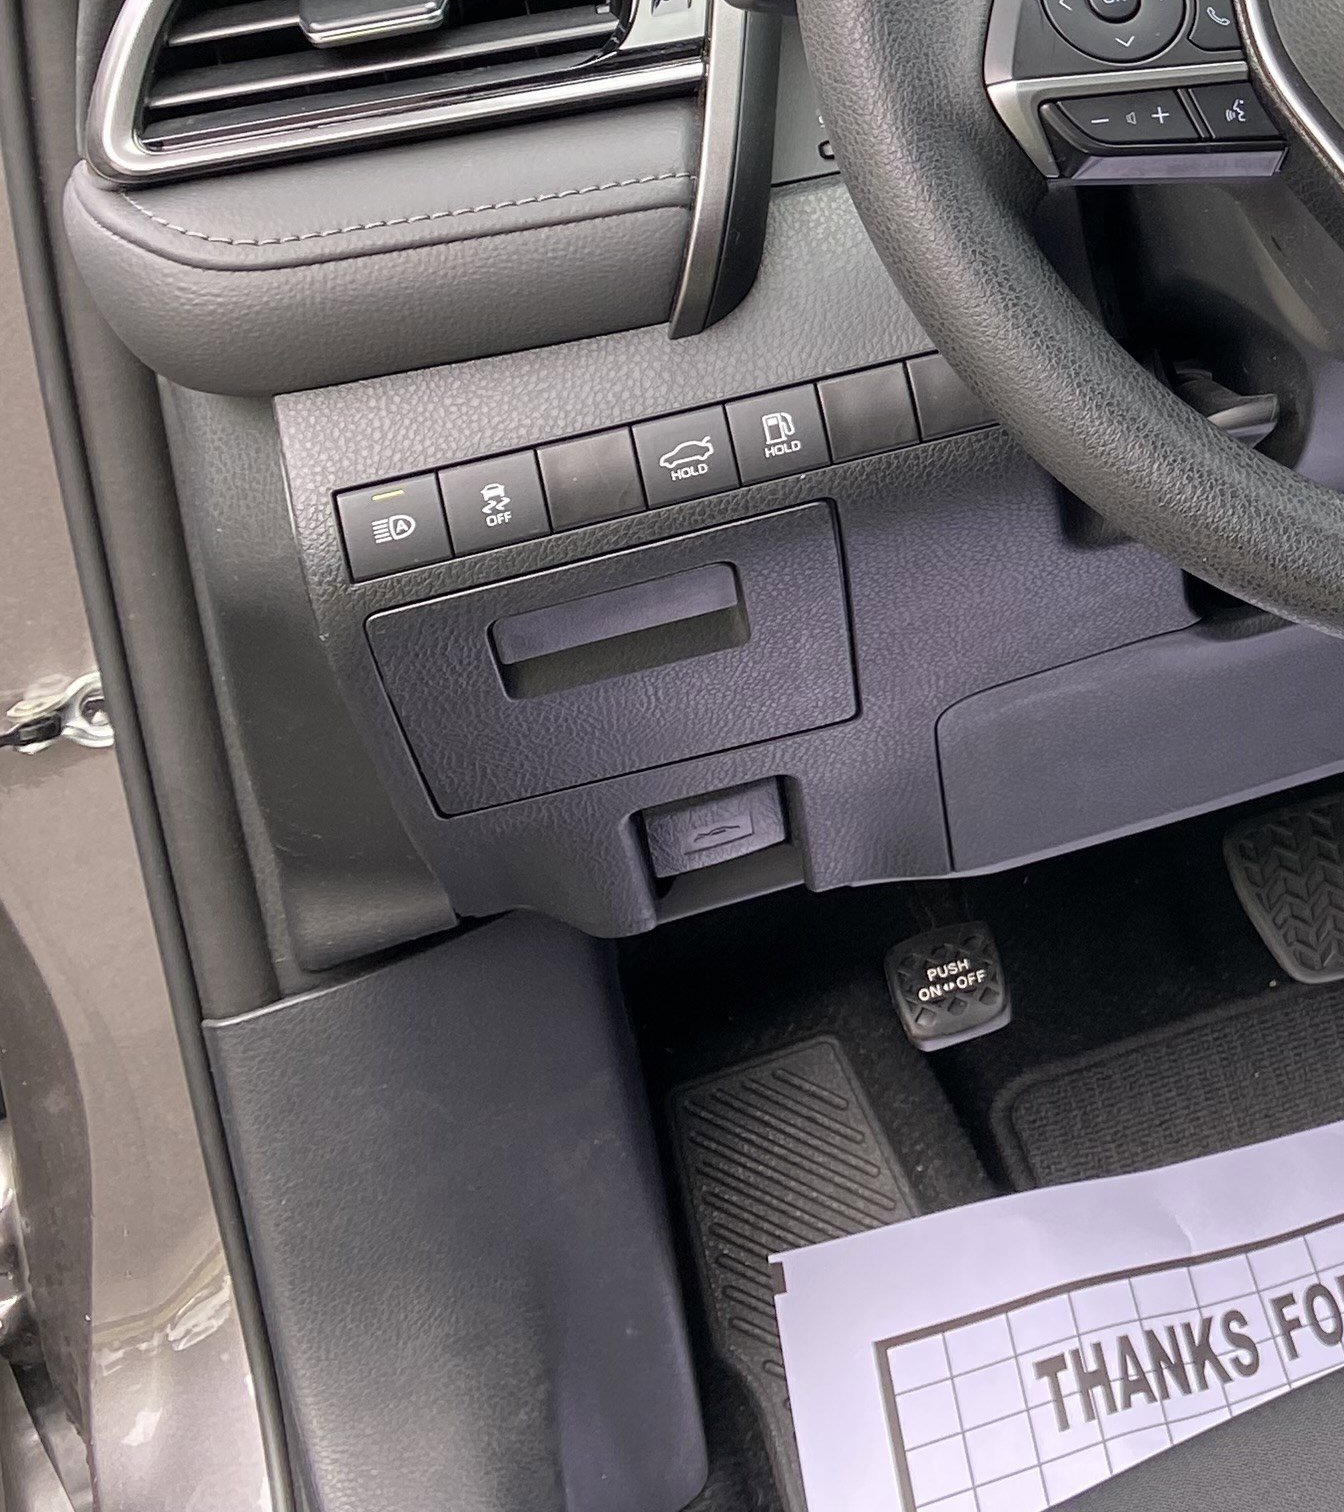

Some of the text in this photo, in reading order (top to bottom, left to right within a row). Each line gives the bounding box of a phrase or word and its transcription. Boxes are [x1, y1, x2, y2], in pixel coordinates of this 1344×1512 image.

[764, 440, 801, 458] HOLD
[670, 463, 708, 481] HOLD
[486, 510, 512, 528] OFF
[926, 958, 971, 982] PUSH
[1032, 1308, 1260, 1432] THANKS
